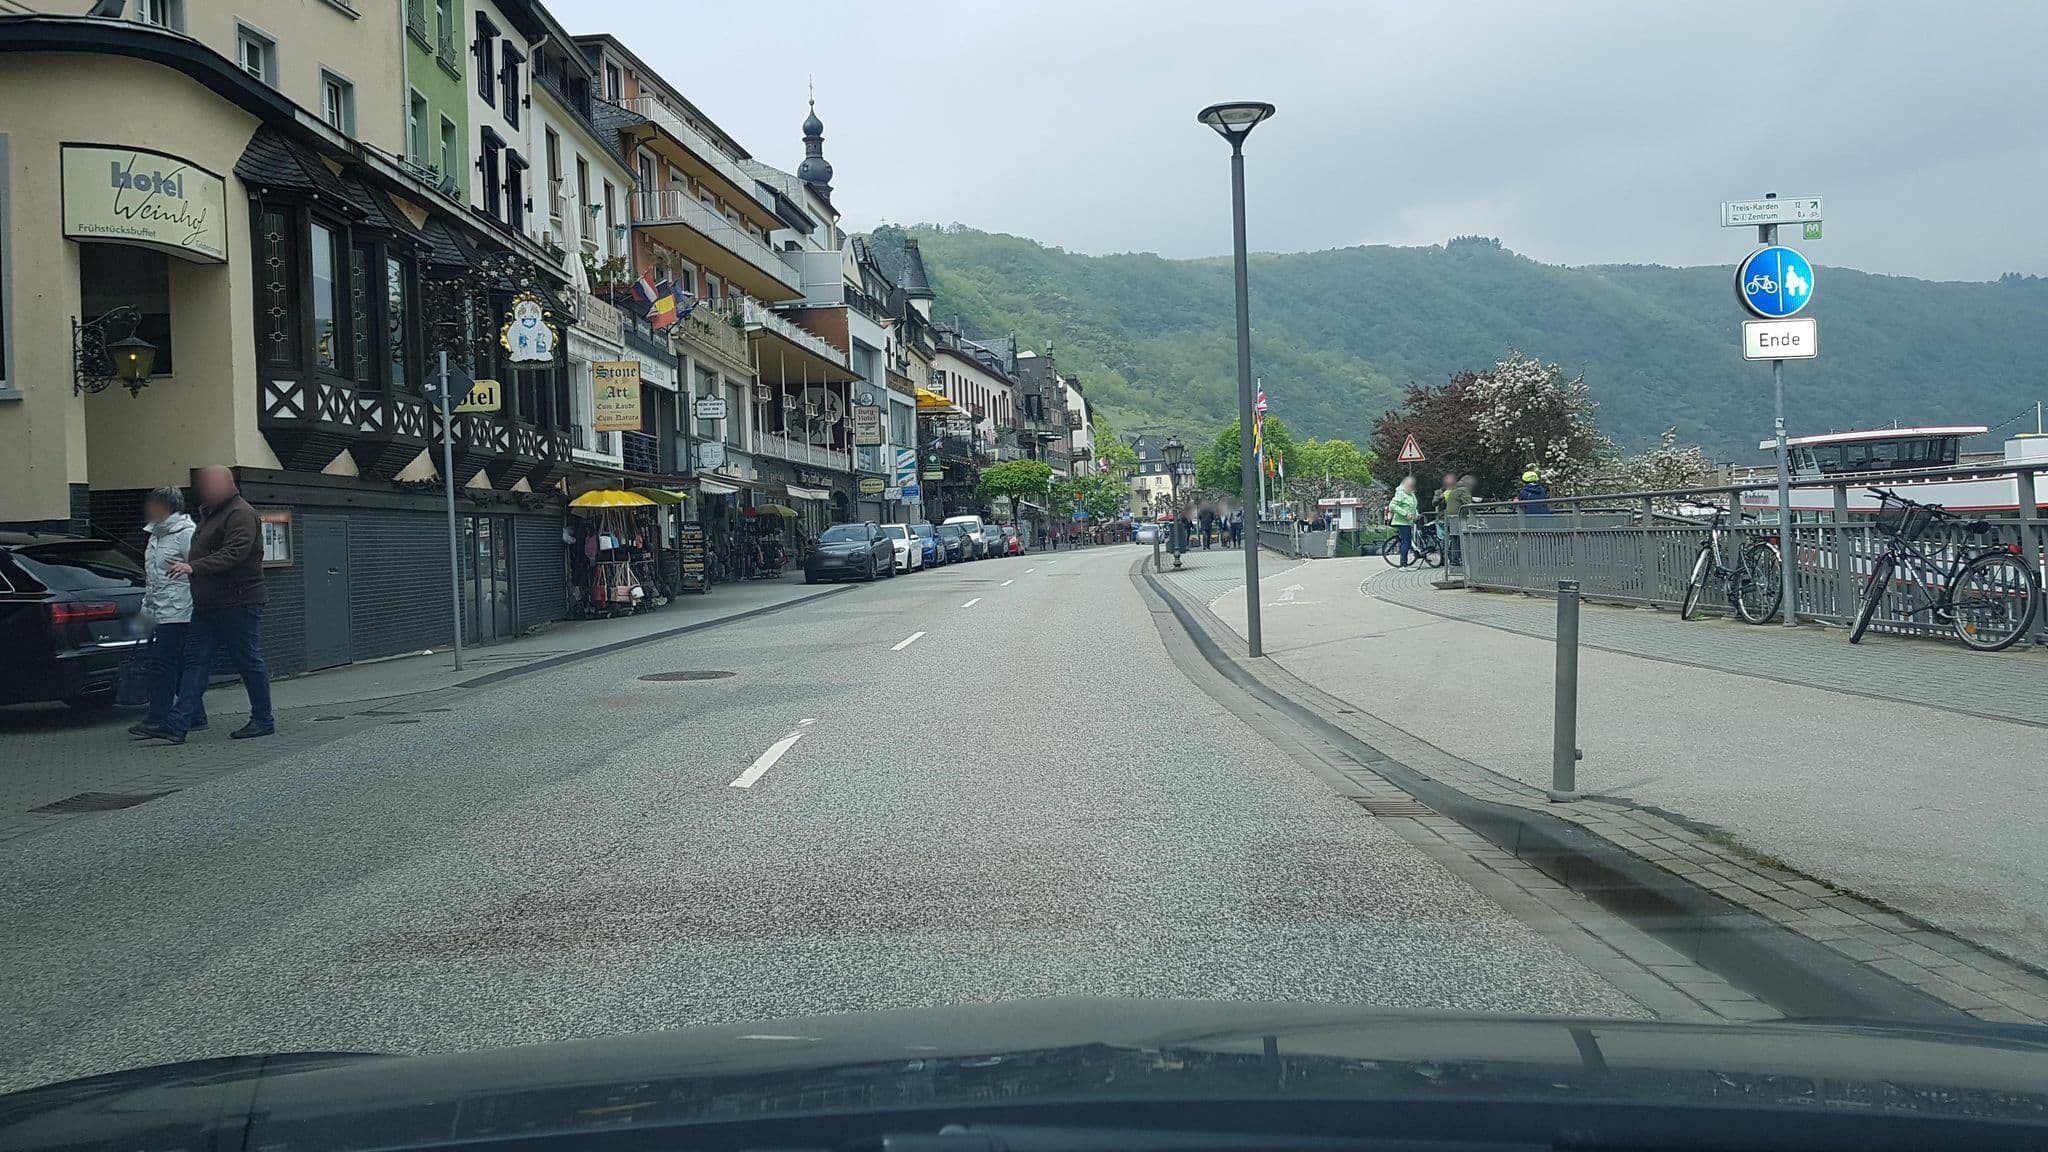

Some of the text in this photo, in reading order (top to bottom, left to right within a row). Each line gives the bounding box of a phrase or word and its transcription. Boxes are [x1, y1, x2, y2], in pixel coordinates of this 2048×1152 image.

[110, 161, 184, 199] hotel
[113, 153, 208, 245] Weinhof
[1732, 201, 1801, 212] Treis-Karden 12
[1748, 212, 1778, 220] Zentrum
[78, 223, 156, 238] Frühstücksbuffet
[1759, 333, 1800, 347] Ende
[595, 365, 637, 379] Stone
[459, 387, 495, 406] otel
[606, 386, 628, 399] Art
